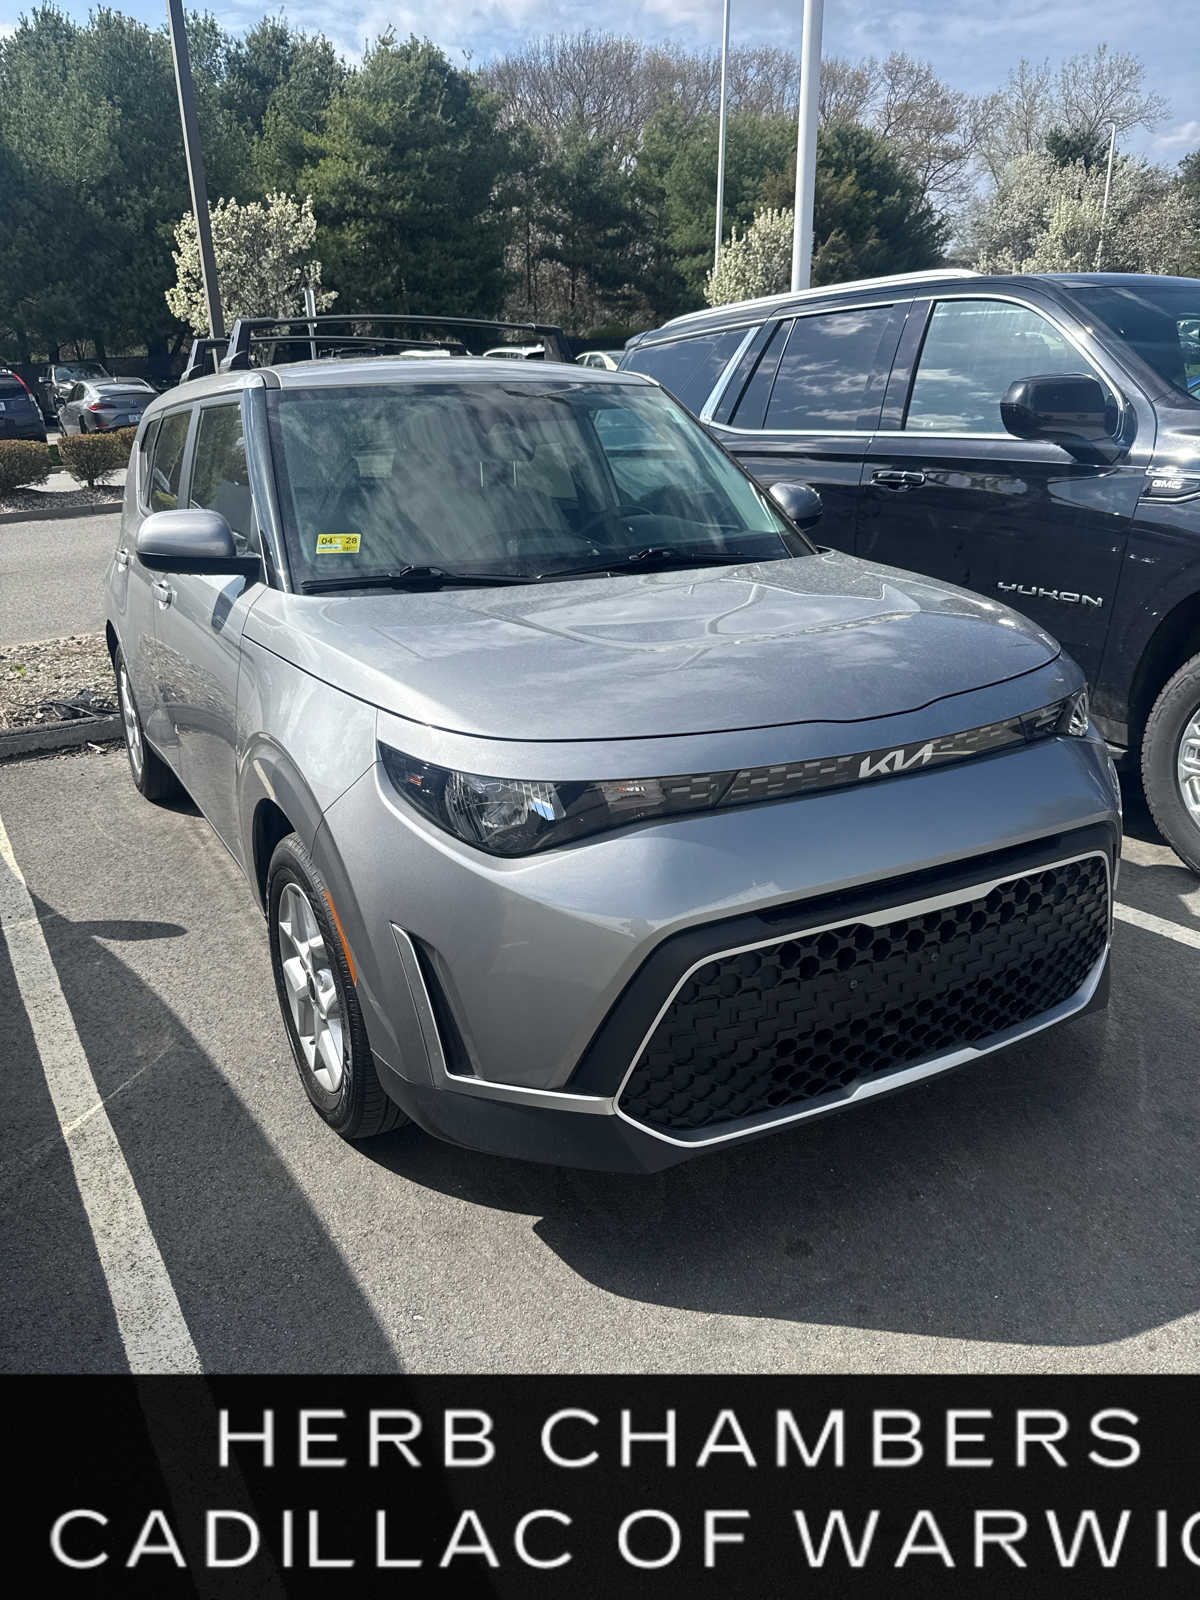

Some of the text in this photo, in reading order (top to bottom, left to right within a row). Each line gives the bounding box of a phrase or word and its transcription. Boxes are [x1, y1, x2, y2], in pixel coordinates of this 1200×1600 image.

[1152, 479, 1183, 490] GMC
[321, 537, 333, 545] 04
[997, 582, 1103, 607] YUKON
[858, 743, 934, 777] KIA
